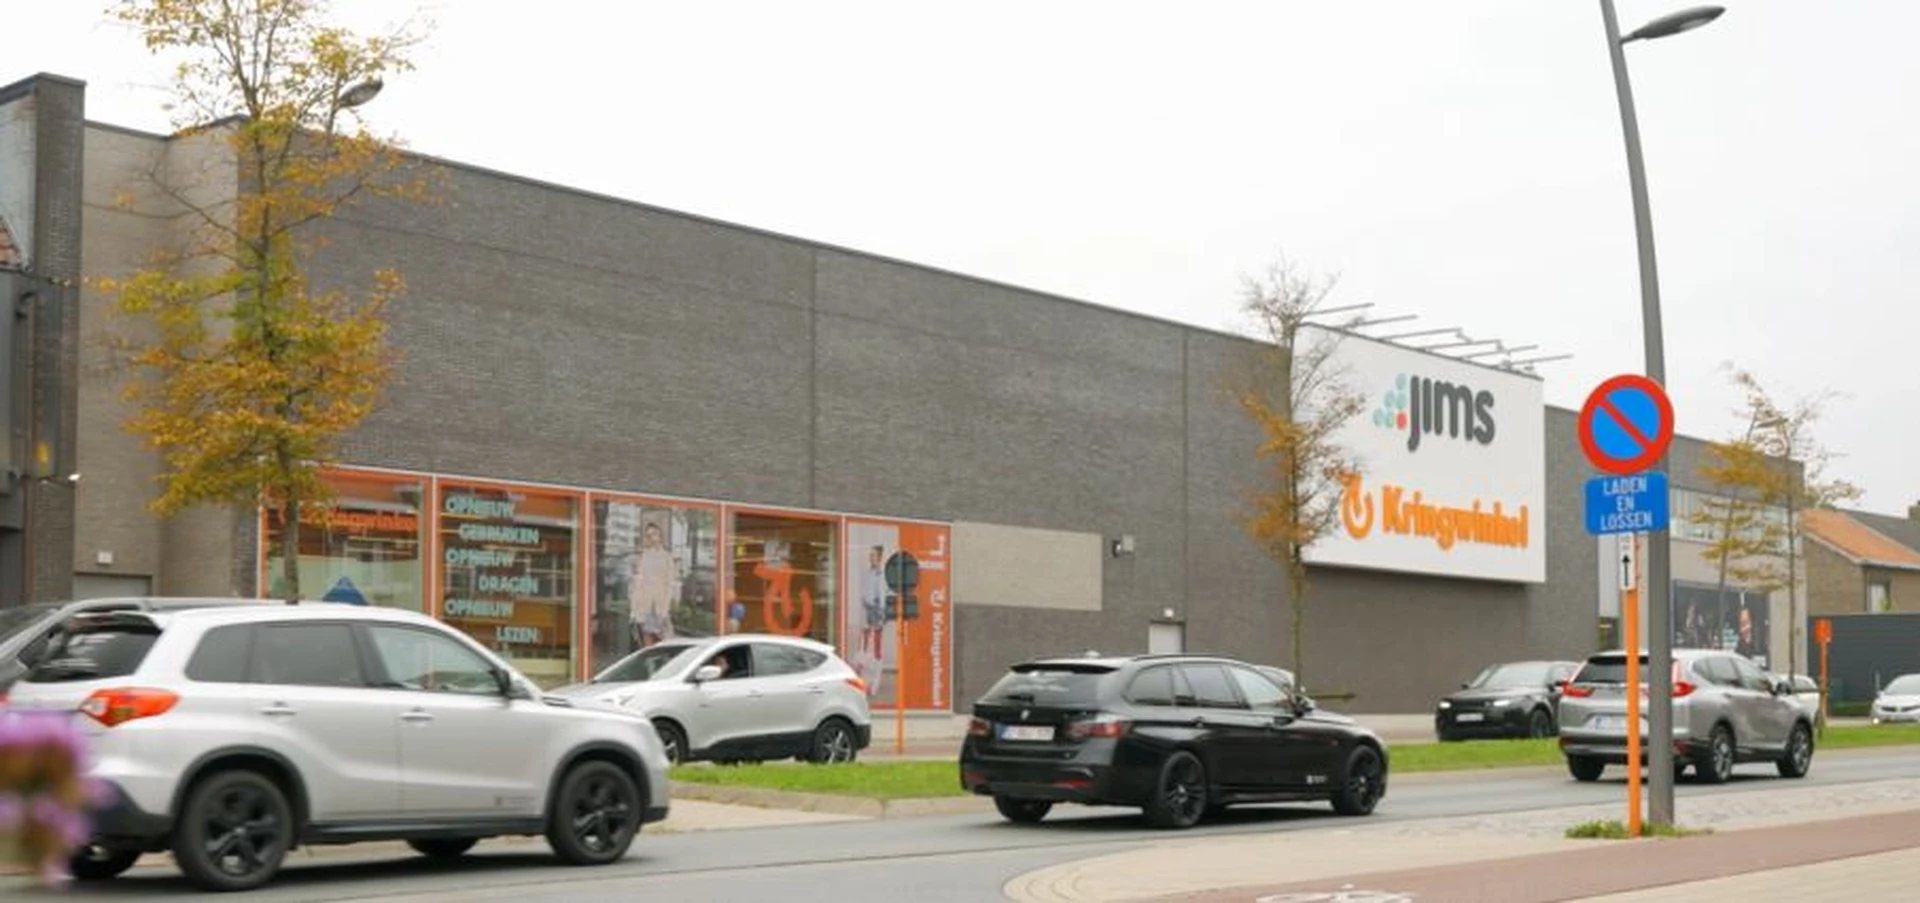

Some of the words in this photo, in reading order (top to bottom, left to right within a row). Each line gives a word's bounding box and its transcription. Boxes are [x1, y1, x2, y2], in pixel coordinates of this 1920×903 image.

[1603, 477, 1647, 494] LADEN
[446, 495, 515, 519] OPNIEUW
[1616, 495, 1635, 512] EN
[1382, 485, 1528, 550] Kringwinkel
[1601, 510, 1654, 531] LOSSEN
[446, 547, 514, 567] OPNIEUW
[479, 575, 538, 594] DRAGEN
[444, 598, 514, 618] OPNIEUW
[496, 626, 538, 645] LEZEN
